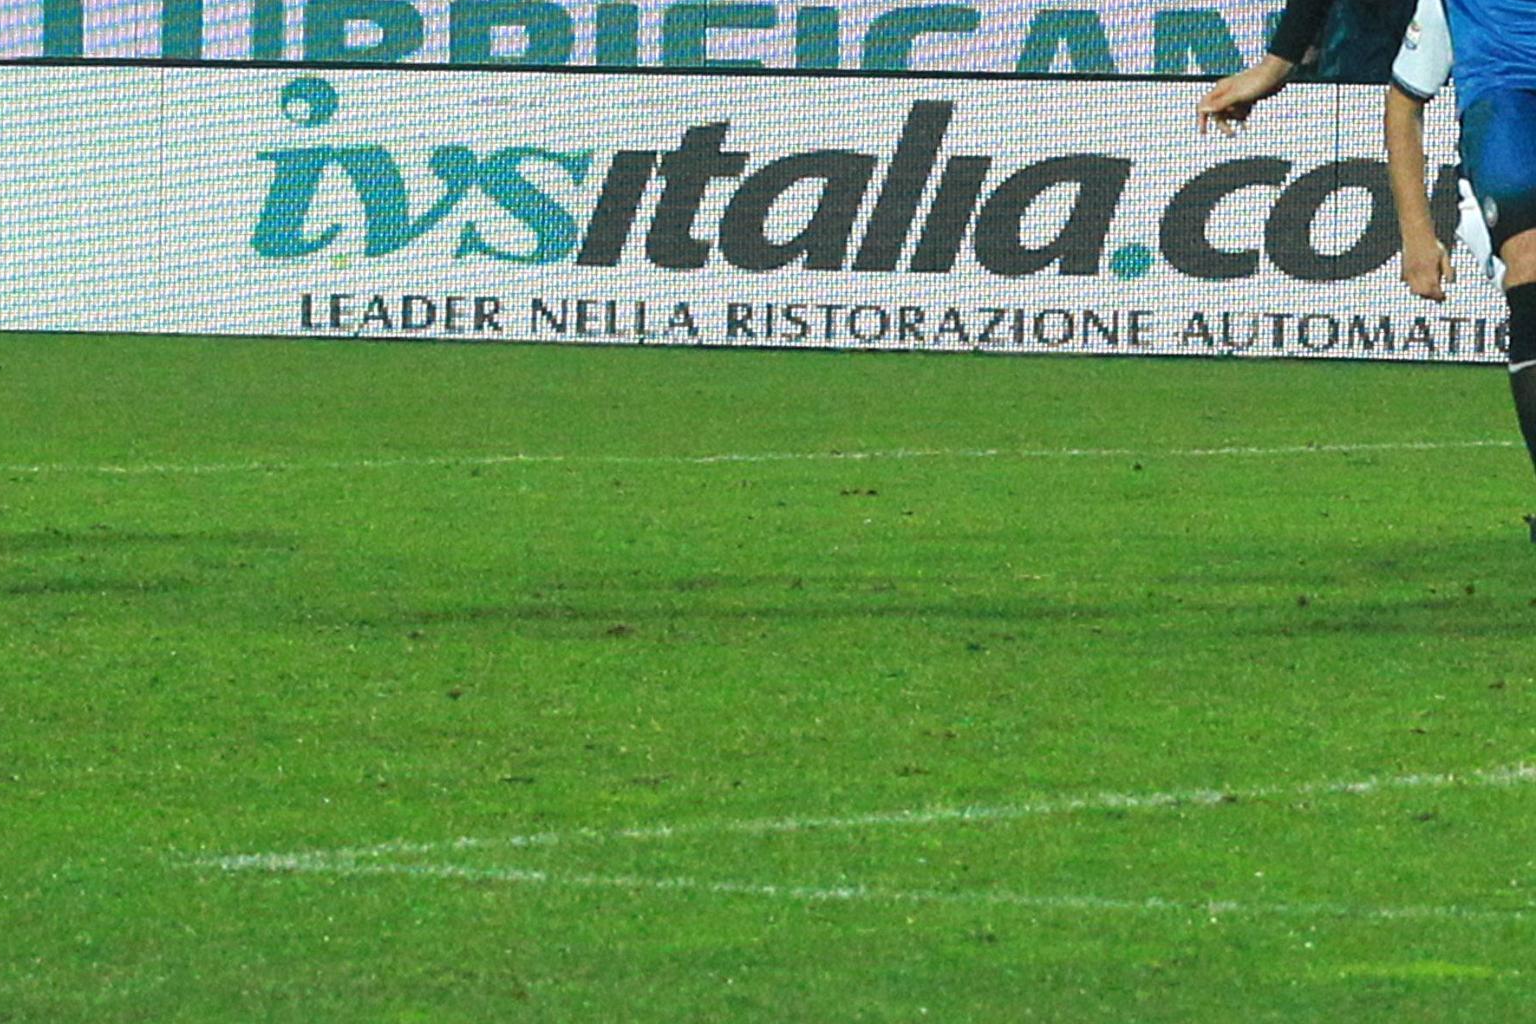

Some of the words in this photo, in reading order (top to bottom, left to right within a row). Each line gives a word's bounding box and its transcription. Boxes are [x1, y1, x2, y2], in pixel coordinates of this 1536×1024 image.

[300, 293, 502, 333] LEADER
[532, 298, 701, 339] NELLA
[726, 302, 1153, 349] RISTORAZIONE
